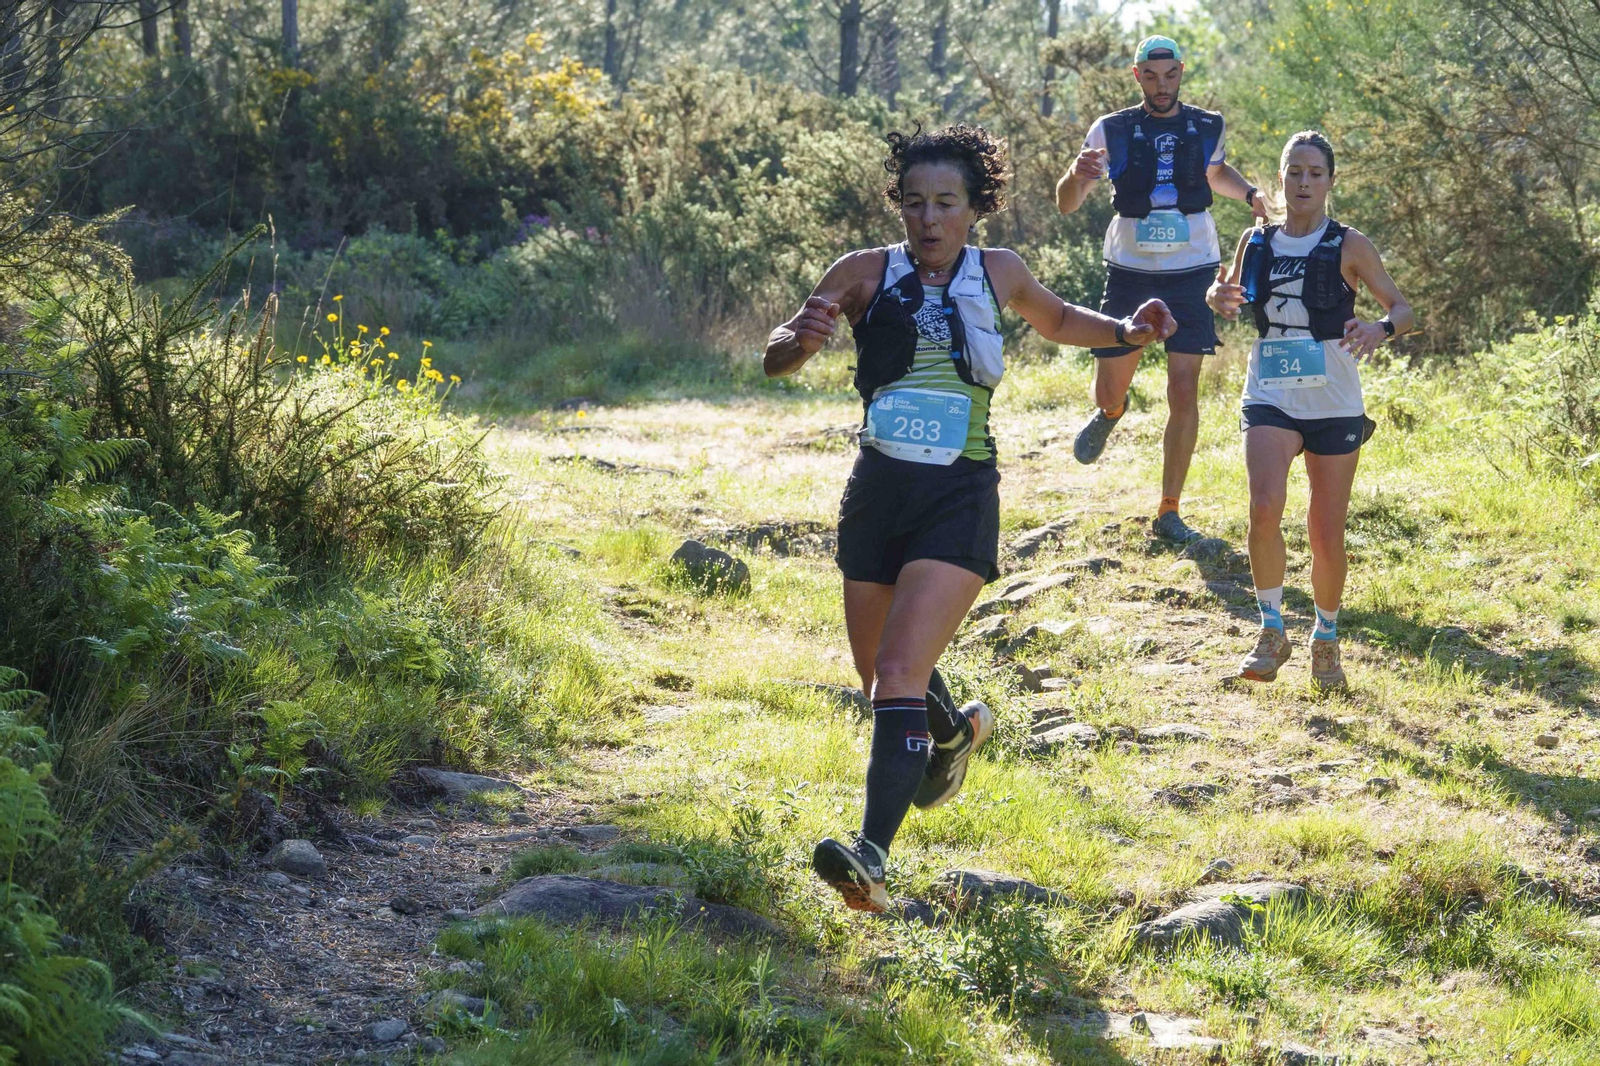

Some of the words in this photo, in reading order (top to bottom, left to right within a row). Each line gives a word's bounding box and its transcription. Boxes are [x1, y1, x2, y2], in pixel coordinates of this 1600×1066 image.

[1148, 226, 1176, 240] 259
[1279, 357, 1302, 375] 34
[892, 415, 942, 442] 283
